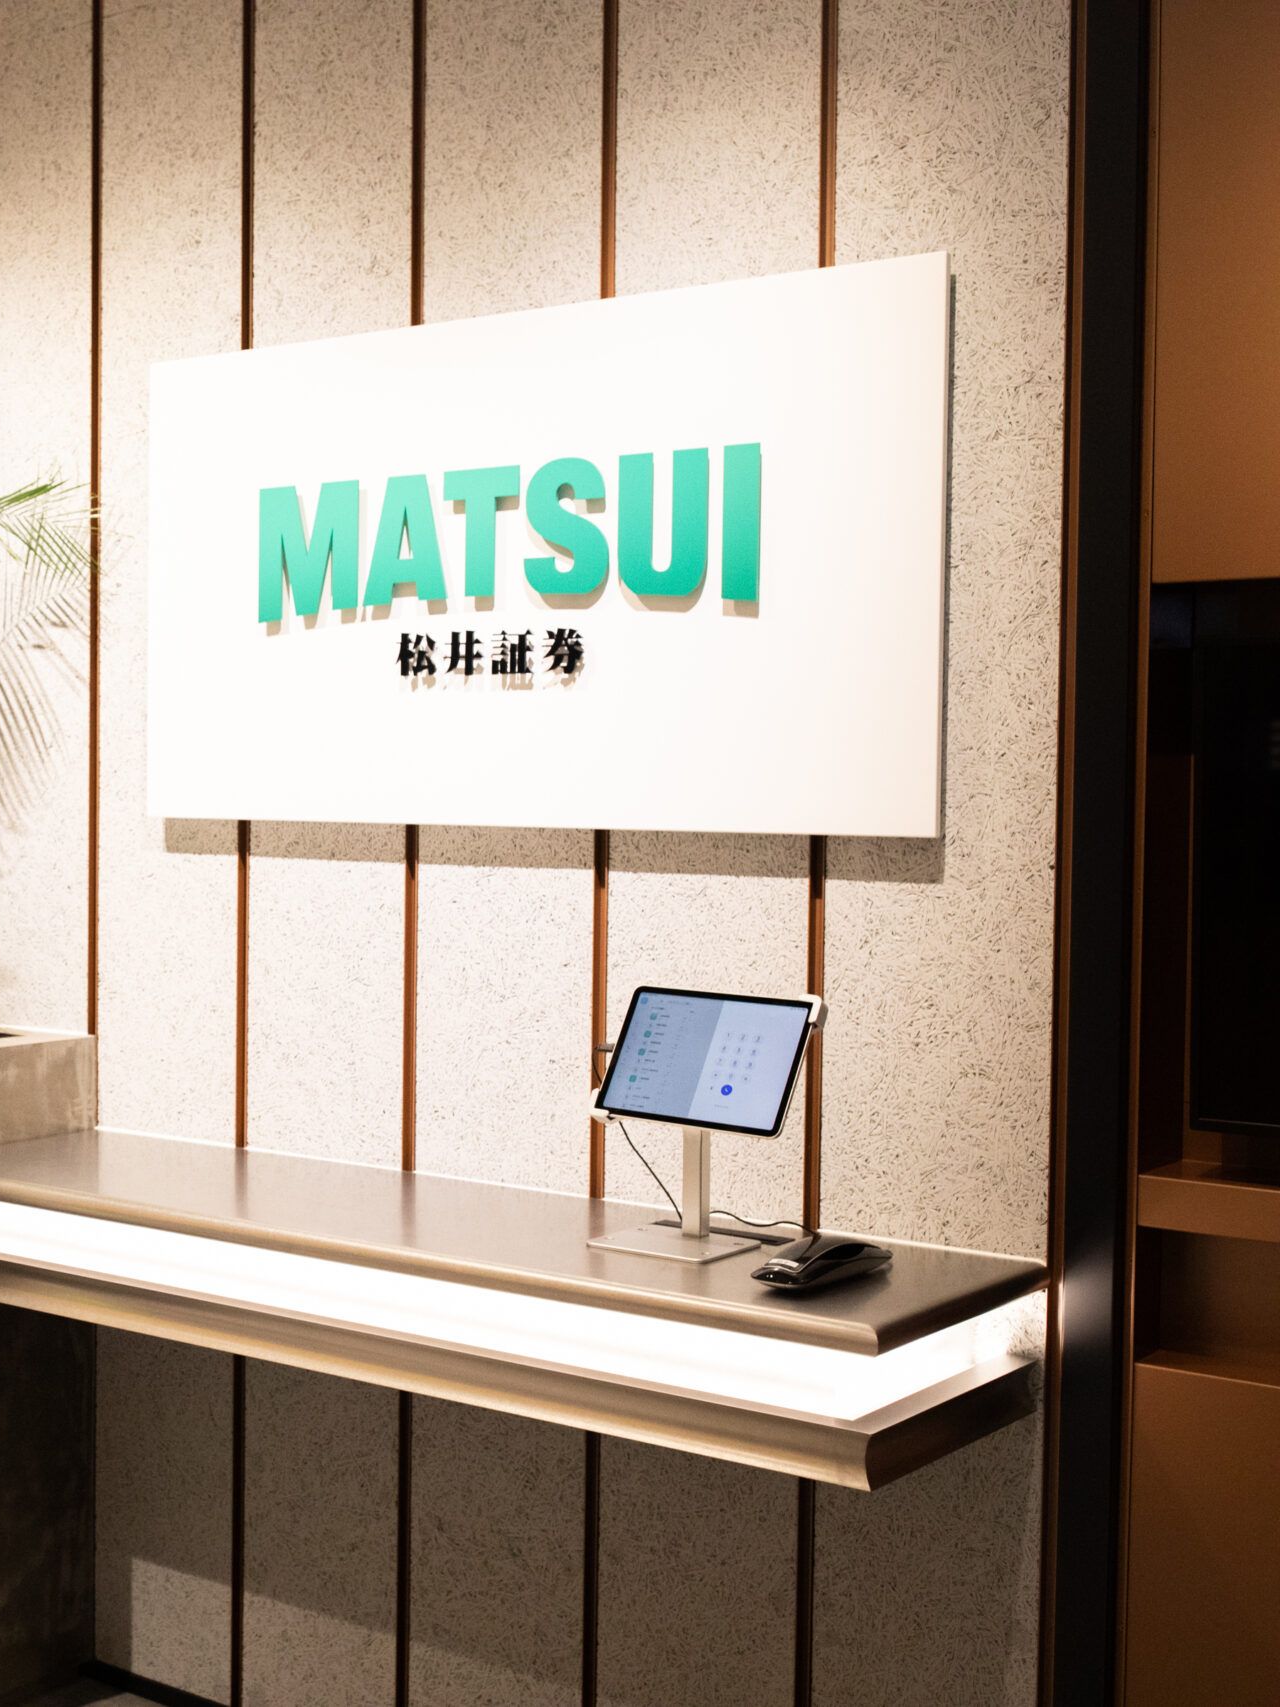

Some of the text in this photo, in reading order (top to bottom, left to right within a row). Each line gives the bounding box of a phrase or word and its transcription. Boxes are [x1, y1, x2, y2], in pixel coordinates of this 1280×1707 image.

[258, 442, 761, 623] MATSUI
[396, 627, 584, 677] 松井証券
